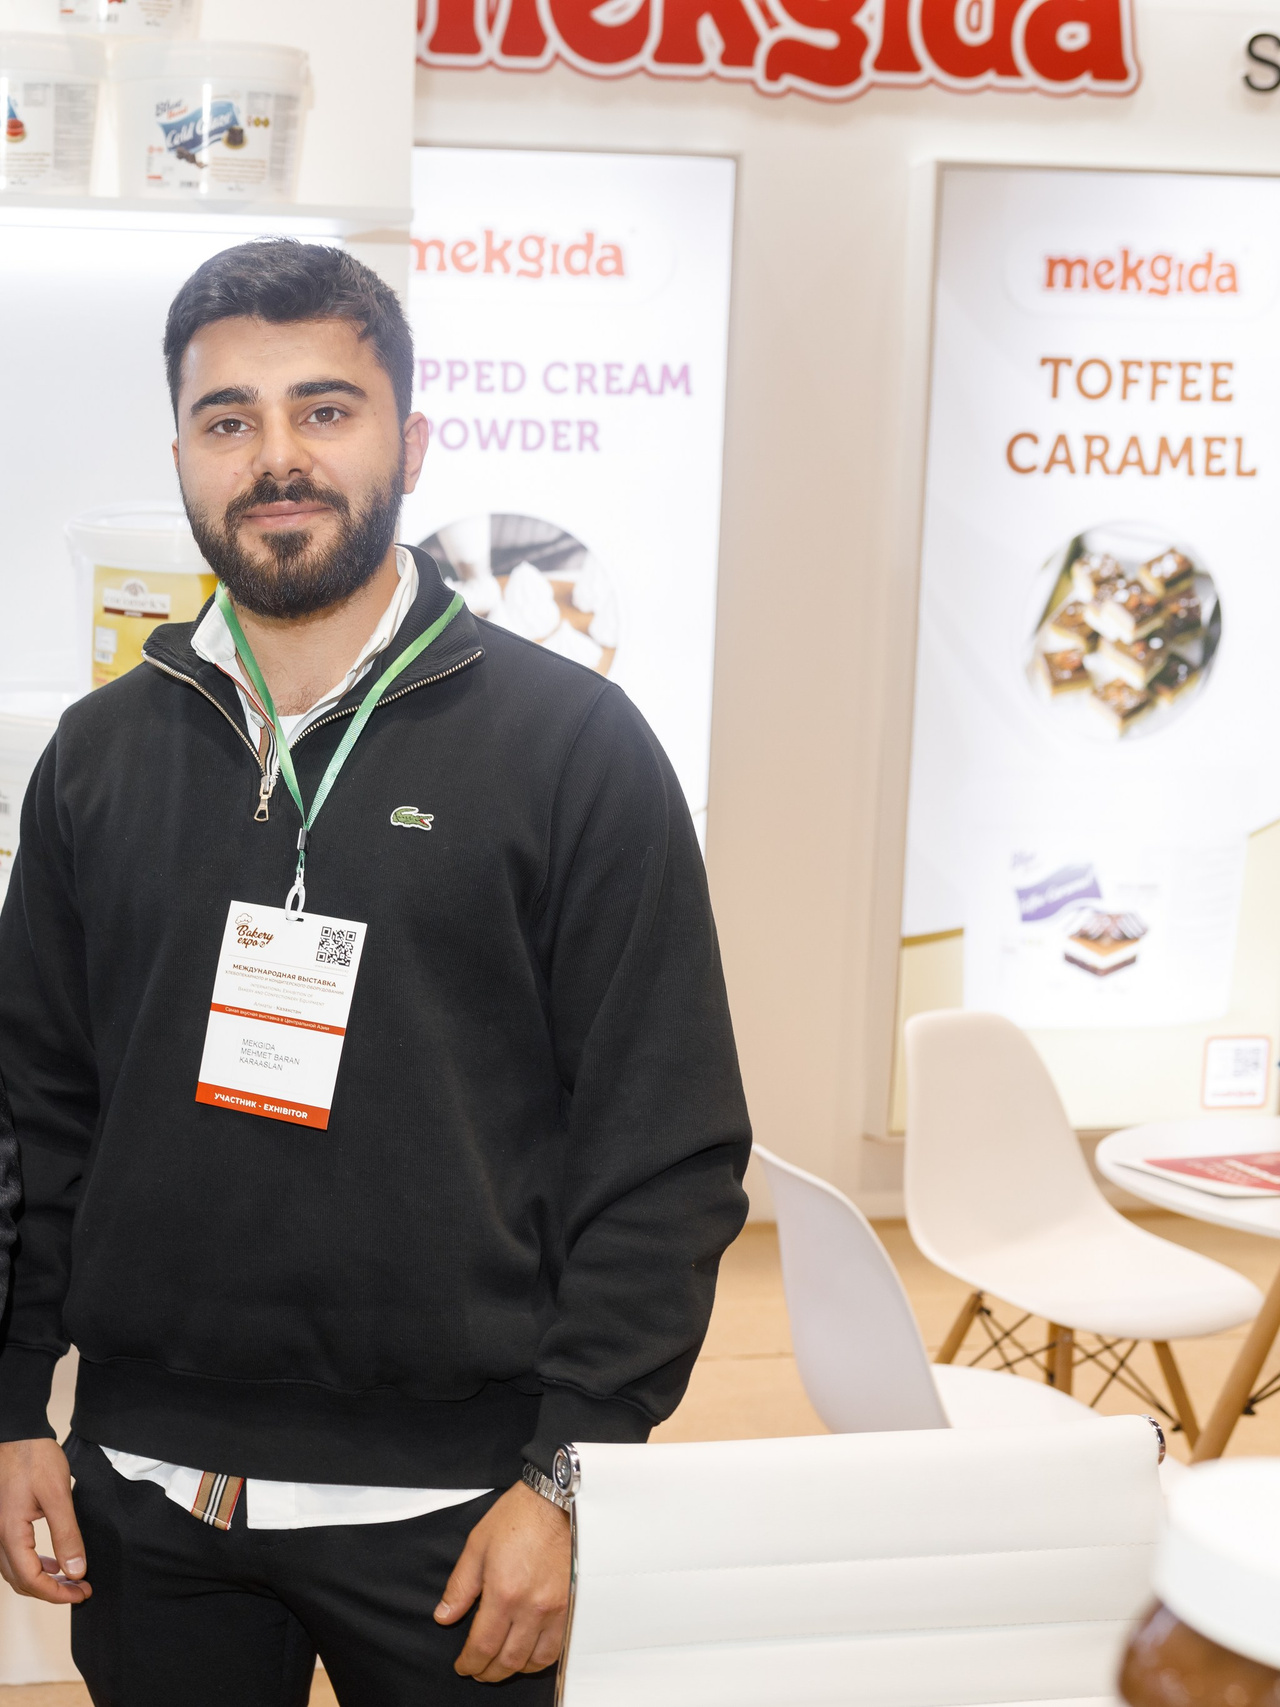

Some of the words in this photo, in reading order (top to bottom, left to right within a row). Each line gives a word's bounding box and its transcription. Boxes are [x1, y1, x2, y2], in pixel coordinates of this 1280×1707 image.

[418, 358, 526, 394] PPED
[542, 361, 692, 396] CREAM
[1040, 357, 1233, 402] TOFFEE
[427, 417, 601, 452] OWDER
[1006, 431, 1257, 477] CARAMEL
[236, 925, 275, 944] Bakery
[237, 936, 259, 949] expo
[232, 963, 296, 980] МЕЖДУНАРОДНАЯ
[298, 975, 337, 988] ВЫСТАВКА
[240, 1047, 273, 1060] MEHMET
[274, 1053, 301, 1065] BARAN
[241, 1038, 276, 1052] MEKGIDA
[239, 1056, 283, 1071] KARAASLAN
[214, 1092, 257, 1109] УЧАСТНИК
[263, 1103, 308, 1119] EXHIBITOR
